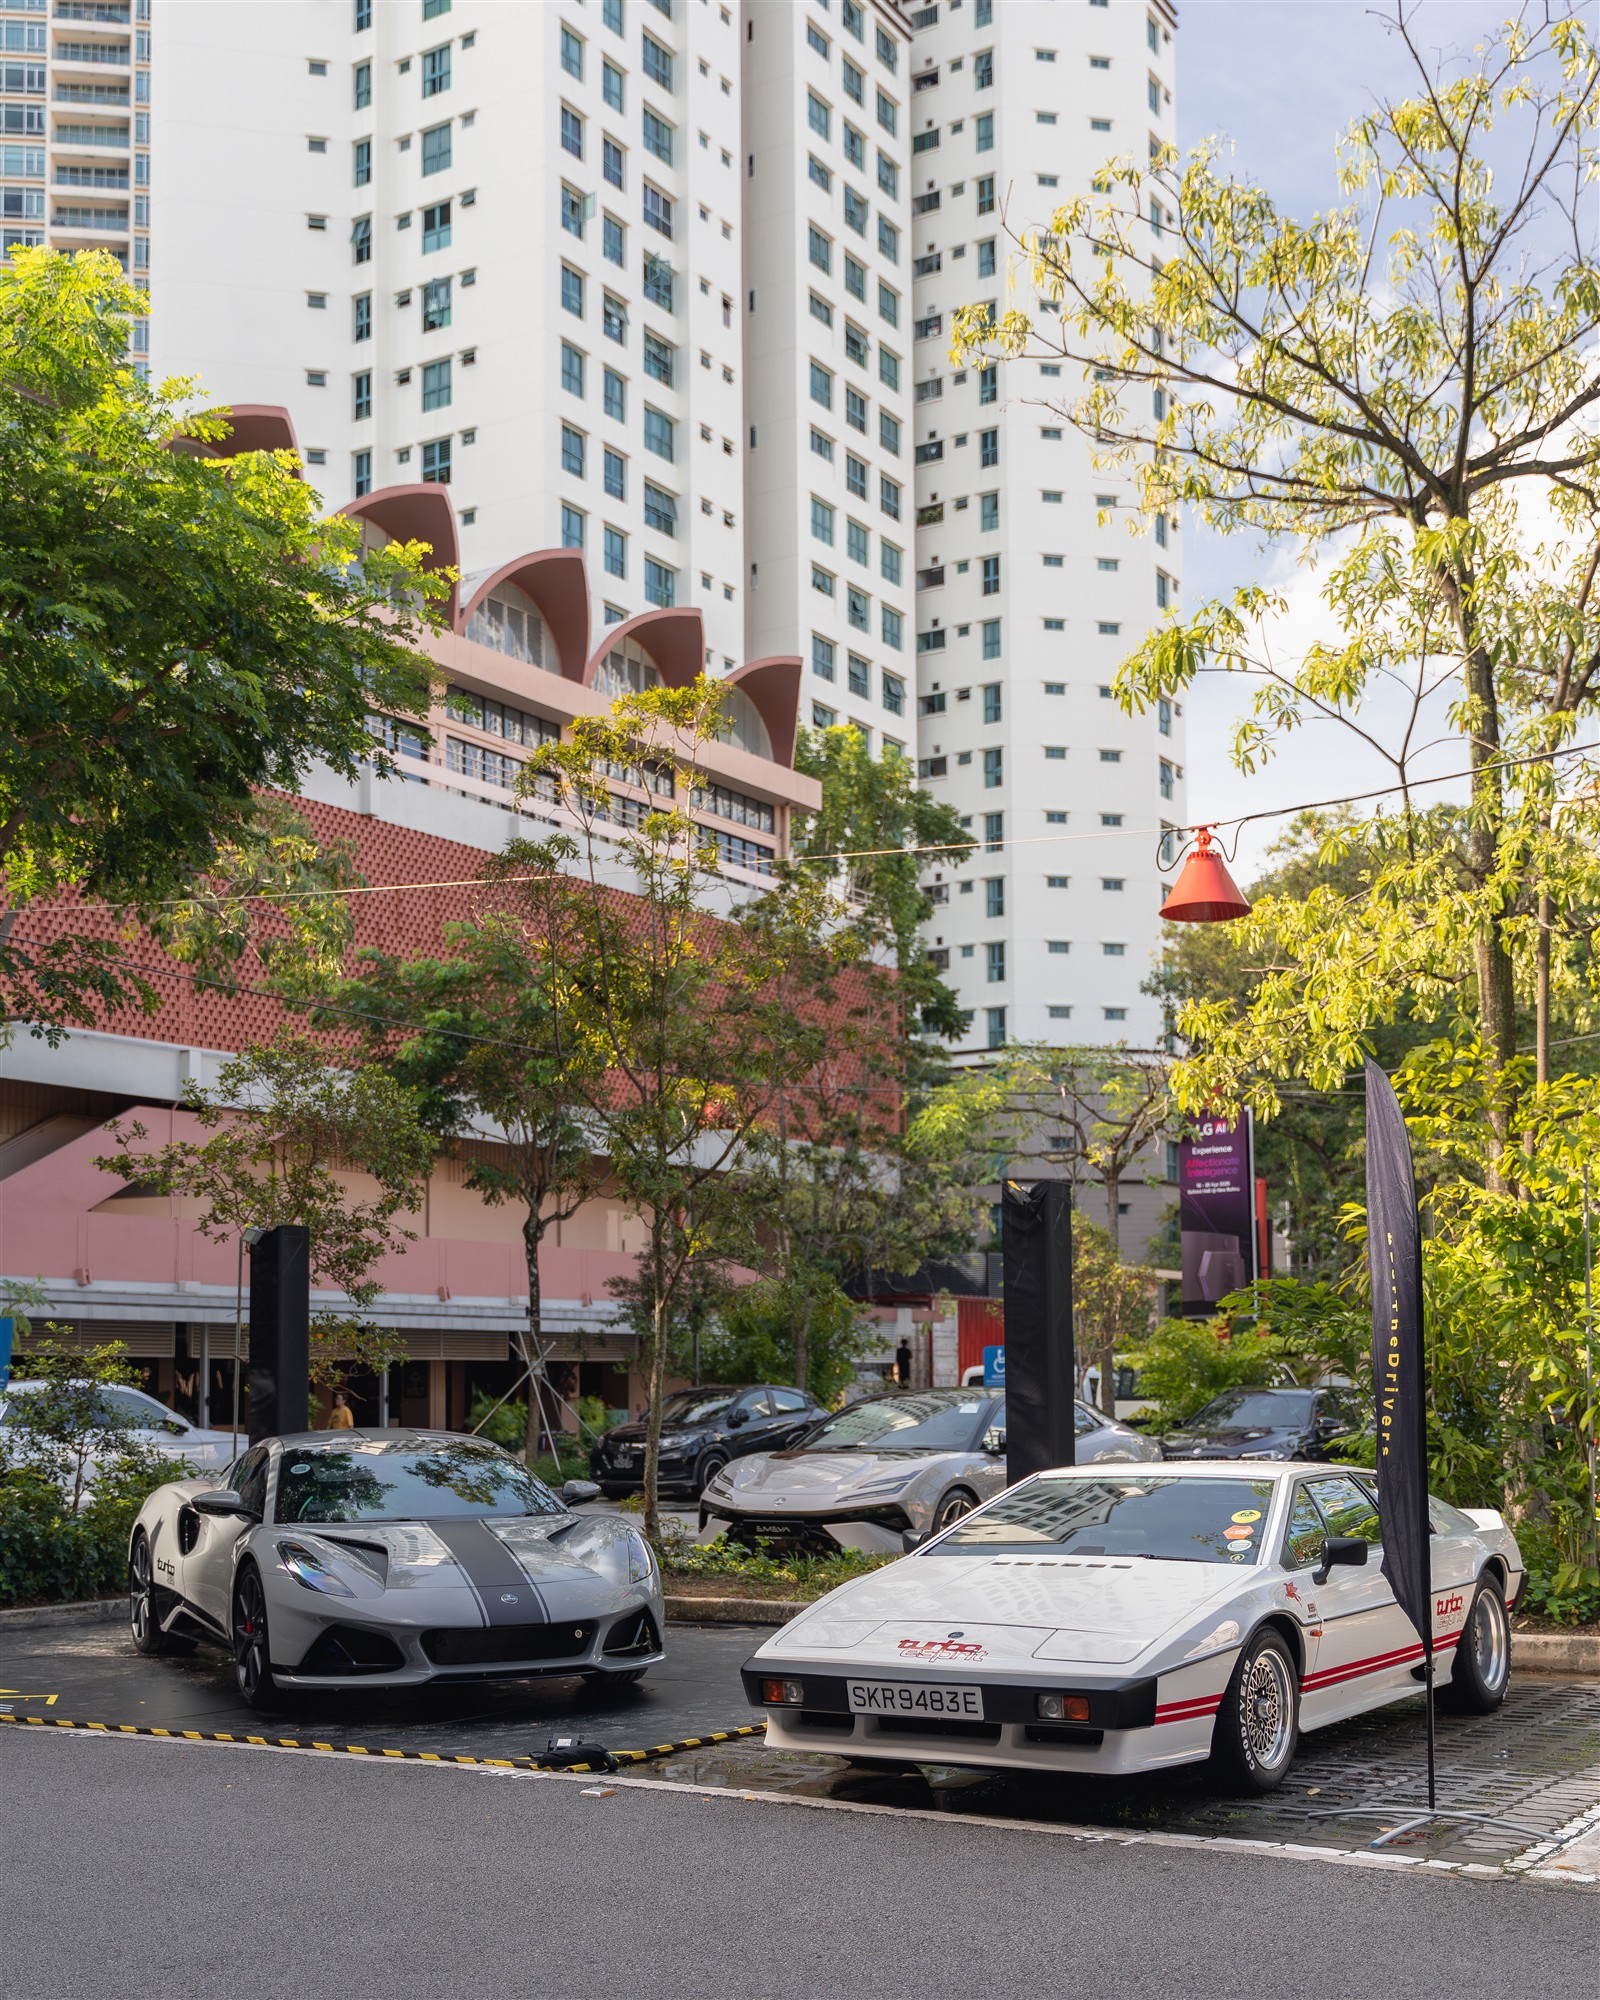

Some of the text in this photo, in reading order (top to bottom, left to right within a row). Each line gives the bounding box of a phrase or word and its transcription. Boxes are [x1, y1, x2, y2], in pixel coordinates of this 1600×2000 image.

[1195, 1122, 1227, 1136] LG AI
[1191, 1145, 1233, 1156] Experience
[1186, 1158, 1240, 1168] Affectionate
[1187, 1167, 1238, 1177] Intelligence
[157, 1557, 175, 1576] turbo
[1436, 1592, 1463, 1616] turbo
[897, 1639, 983, 1652] turbo
[899, 1648, 989, 1663] esprit
[852, 1686, 979, 1714] SKR9483E
[1239, 1659, 1256, 1771] GOODYEAR
